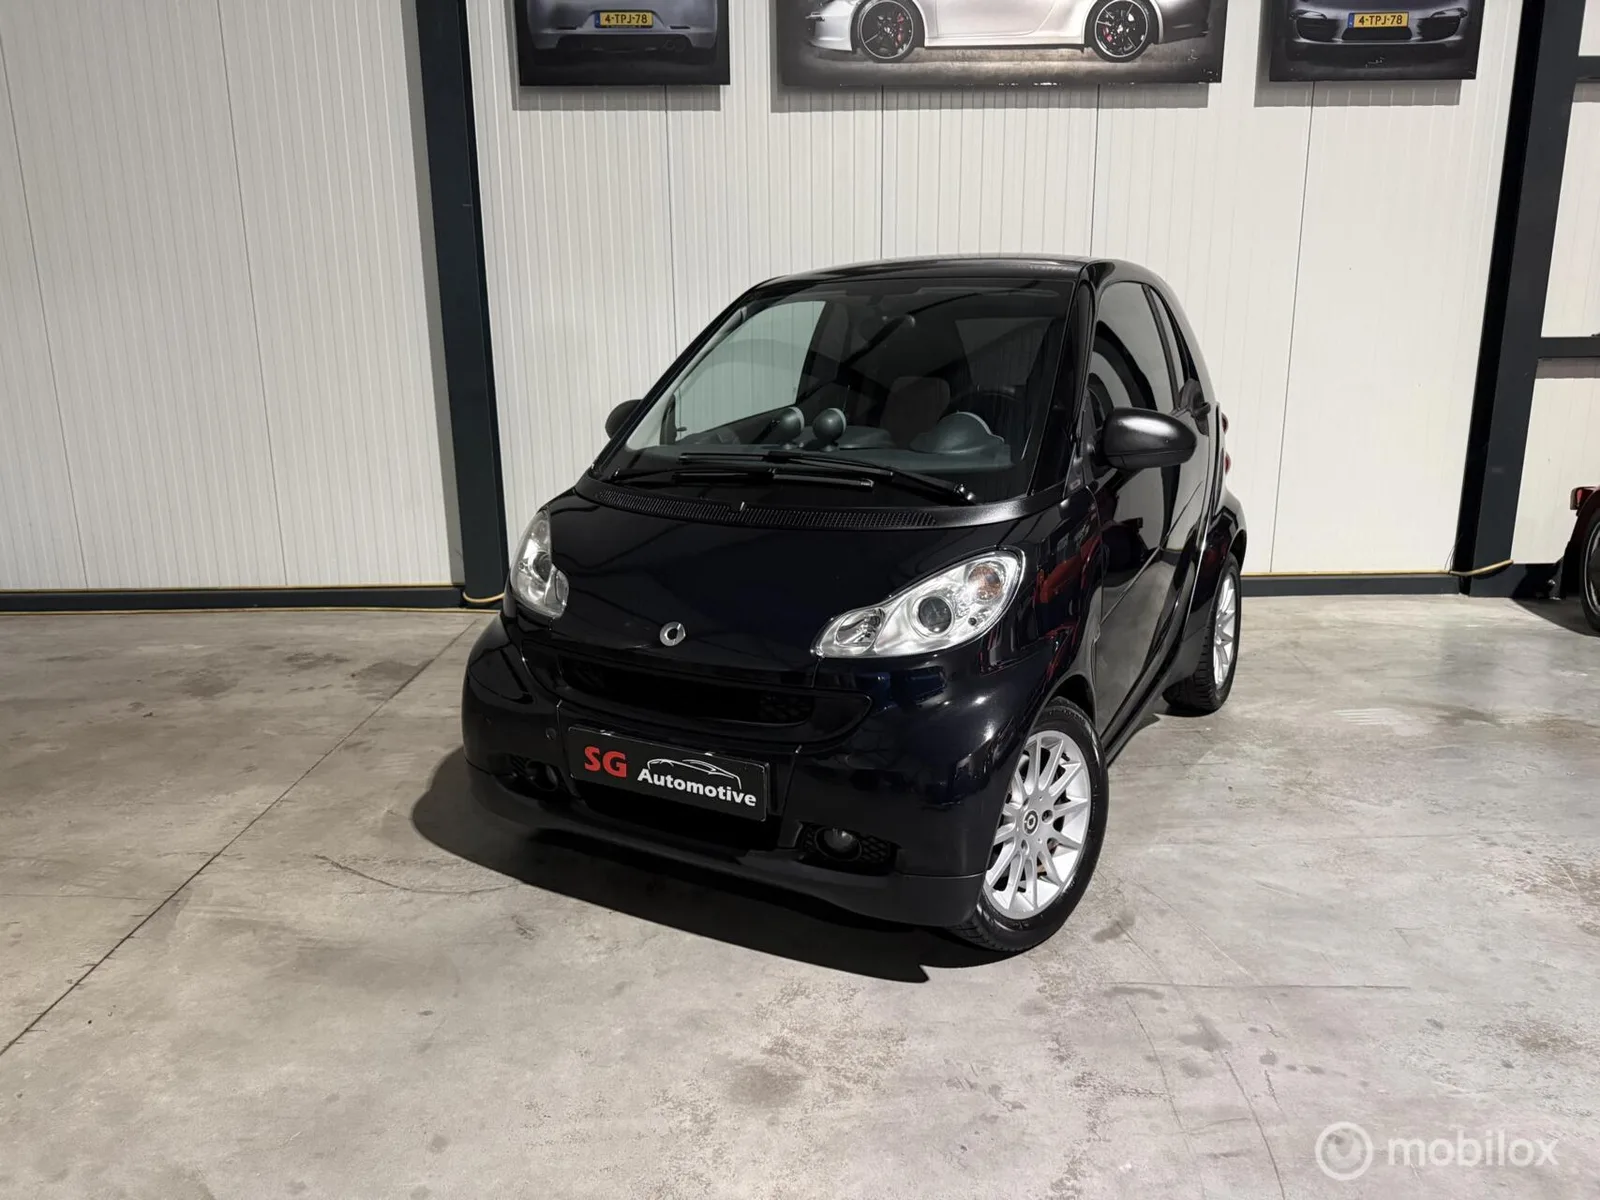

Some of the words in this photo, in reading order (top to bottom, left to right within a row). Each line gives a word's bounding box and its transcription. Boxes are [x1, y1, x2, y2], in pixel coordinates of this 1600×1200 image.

[604, 13, 648, 24] 4-TPJ-78
[1358, 14, 1403, 26] 4-TPJ-78
[584, 745, 627, 778] SG
[637, 768, 757, 807] Automotive
